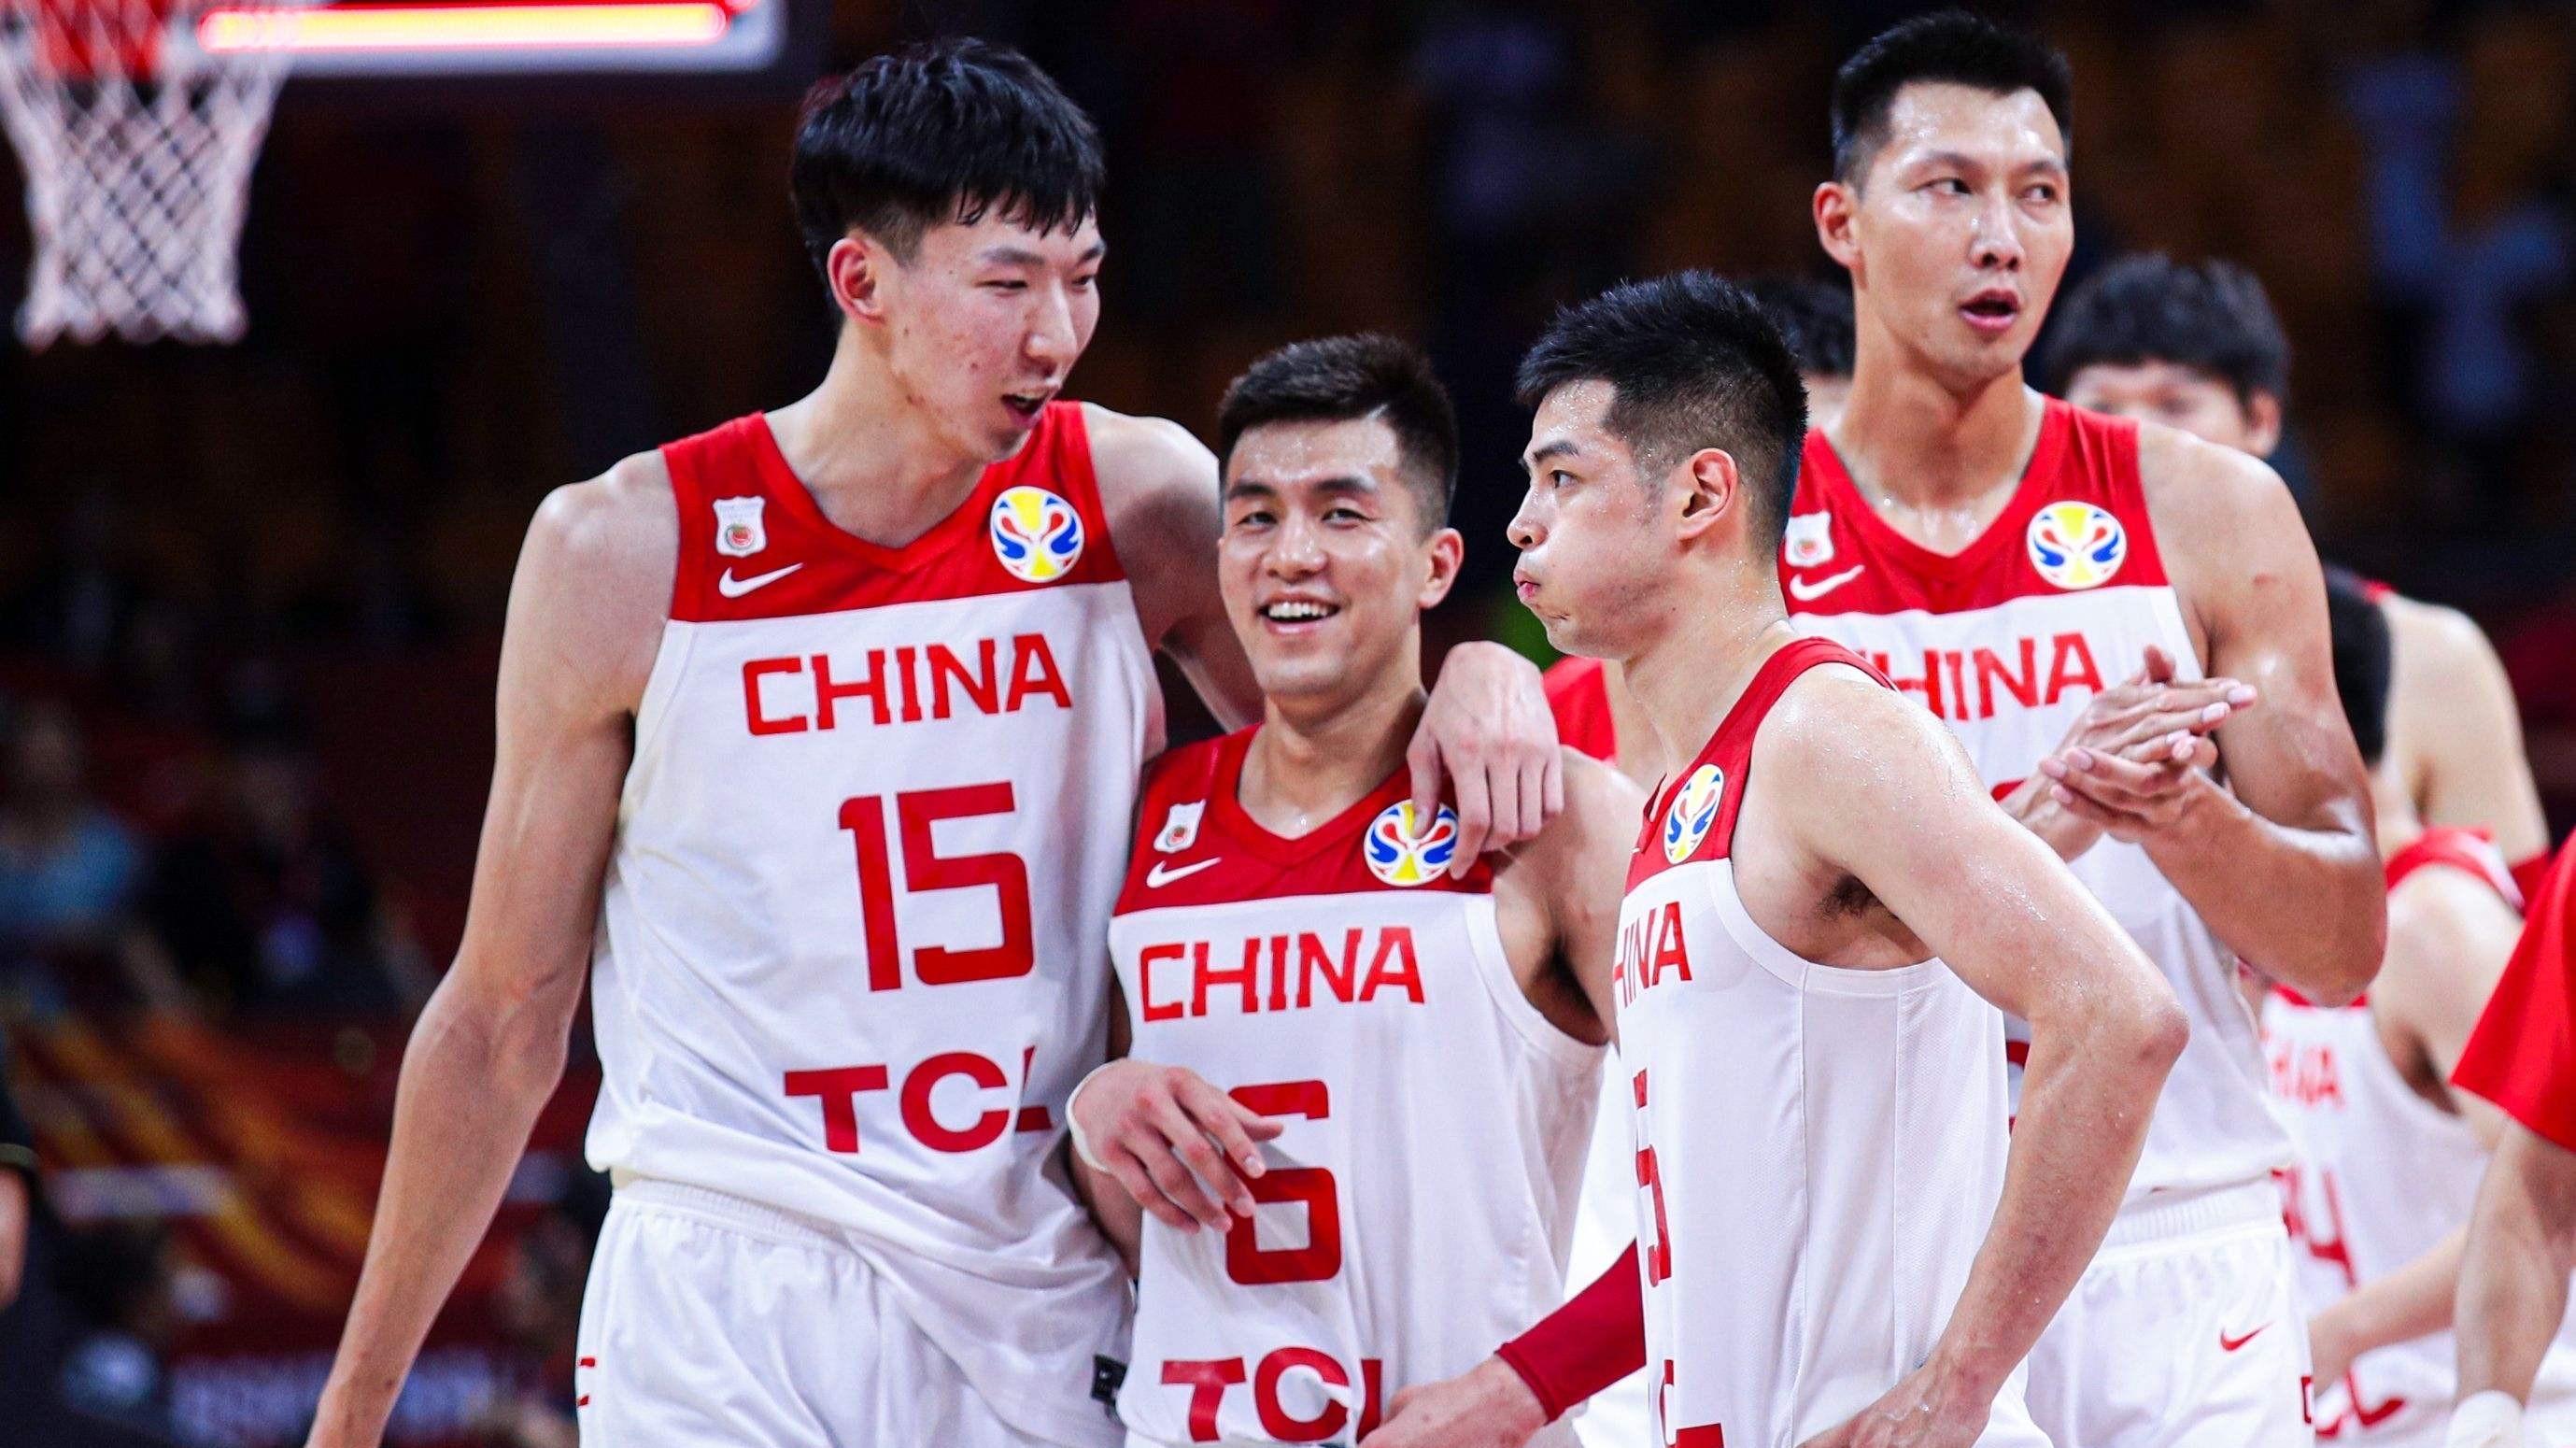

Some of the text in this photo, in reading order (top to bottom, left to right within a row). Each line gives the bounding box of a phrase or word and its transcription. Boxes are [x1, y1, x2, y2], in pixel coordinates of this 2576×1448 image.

[743, 633, 1072, 736] CHINA
[1854, 632, 2104, 722] HINA
[840, 782, 1034, 991] 15
[1140, 928, 1425, 1022] CHINA
[1613, 901, 1692, 1009] HINA
[1225, 1080, 1341, 1285] 6
